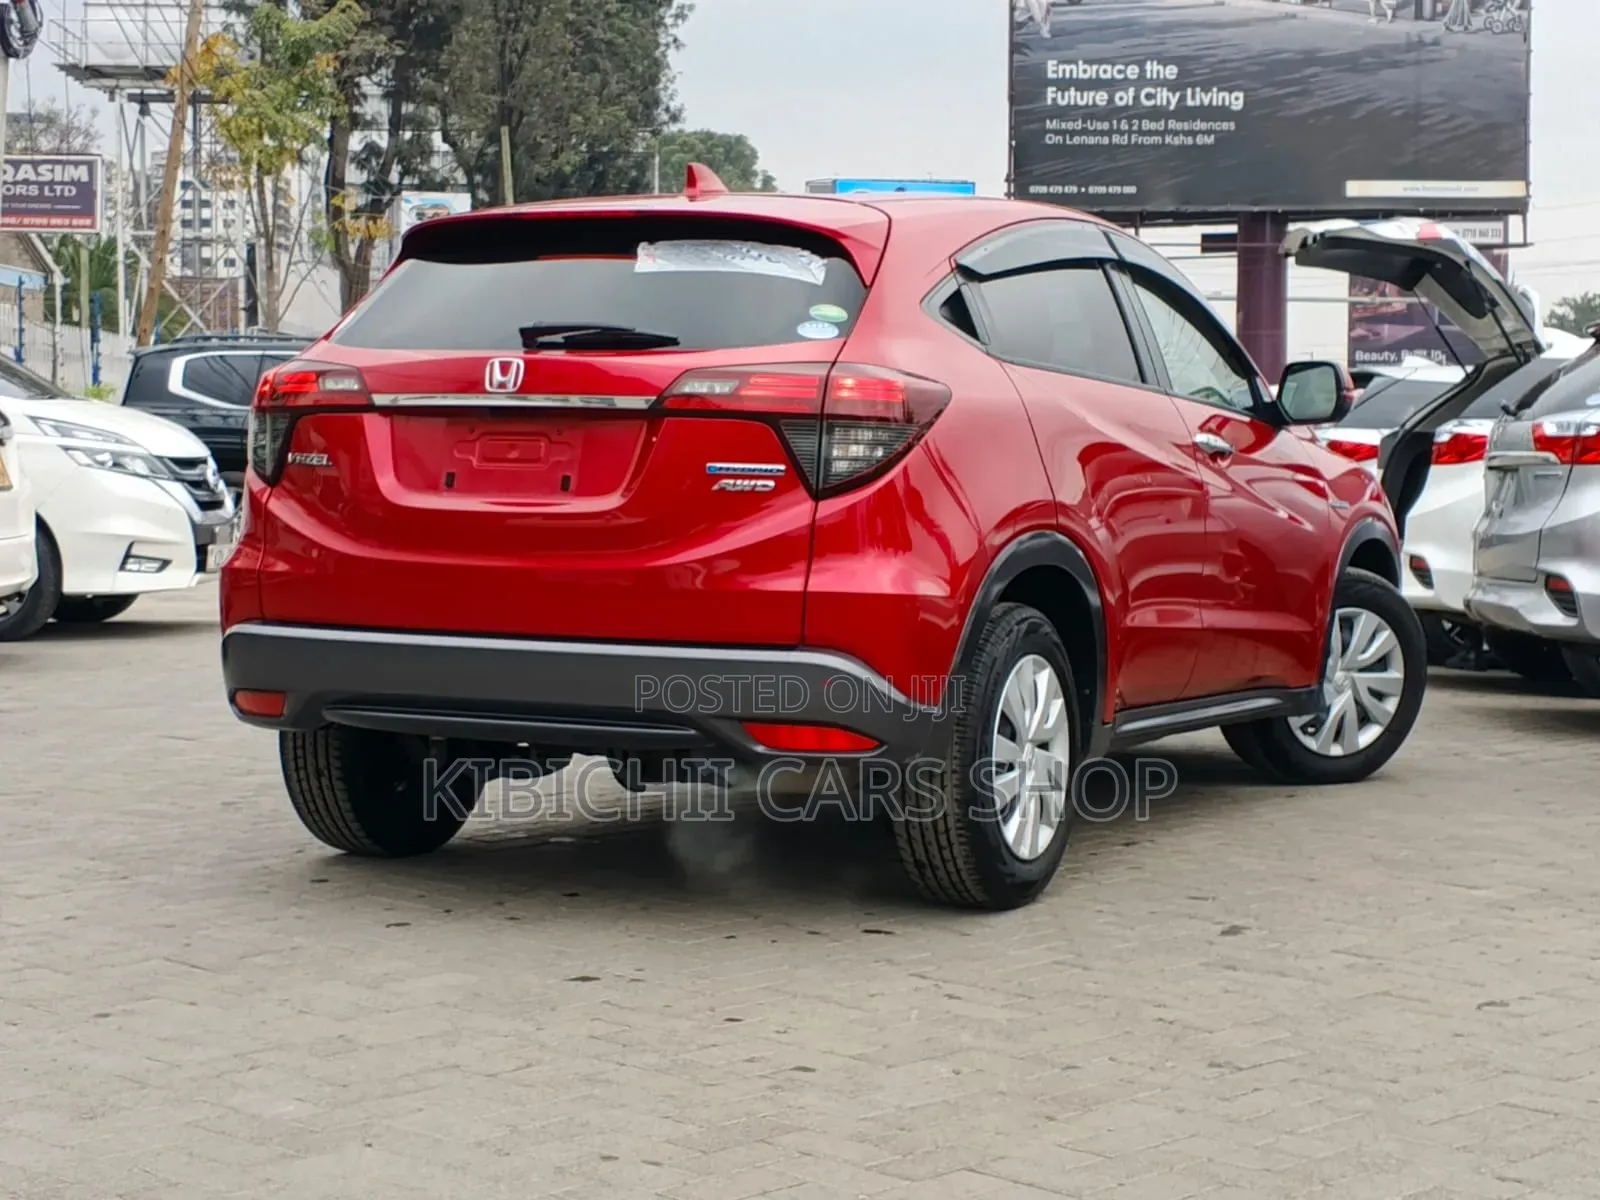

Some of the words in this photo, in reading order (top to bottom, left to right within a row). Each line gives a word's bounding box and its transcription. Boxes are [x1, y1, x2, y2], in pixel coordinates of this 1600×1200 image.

[1046, 60, 1140, 80] Embrace
[1145, 60, 1178, 80] the
[1046, 87, 1108, 107] Future
[1114, 87, 1135, 107] of
[1140, 87, 1181, 111] City
[1186, 87, 1244, 111] Living
[1045, 119, 1110, 131] Mixed-Use
[1112, 120, 1118, 130] 1
[1120, 120, 1129, 131] &
[1132, 120, 1139, 131] 2
[1141, 120, 1165, 131] Bed
[1168, 120, 1235, 131] Residences
[1045, 133, 1063, 145] On
[1066, 133, 1109, 145] Lenana
[1112, 133, 1128, 145] Rd
[1131, 134, 1162, 145] From
[1165, 134, 1193, 145] Kshs
[44, 185, 76, 197] LTD
[711, 479, 776, 492] AWD
